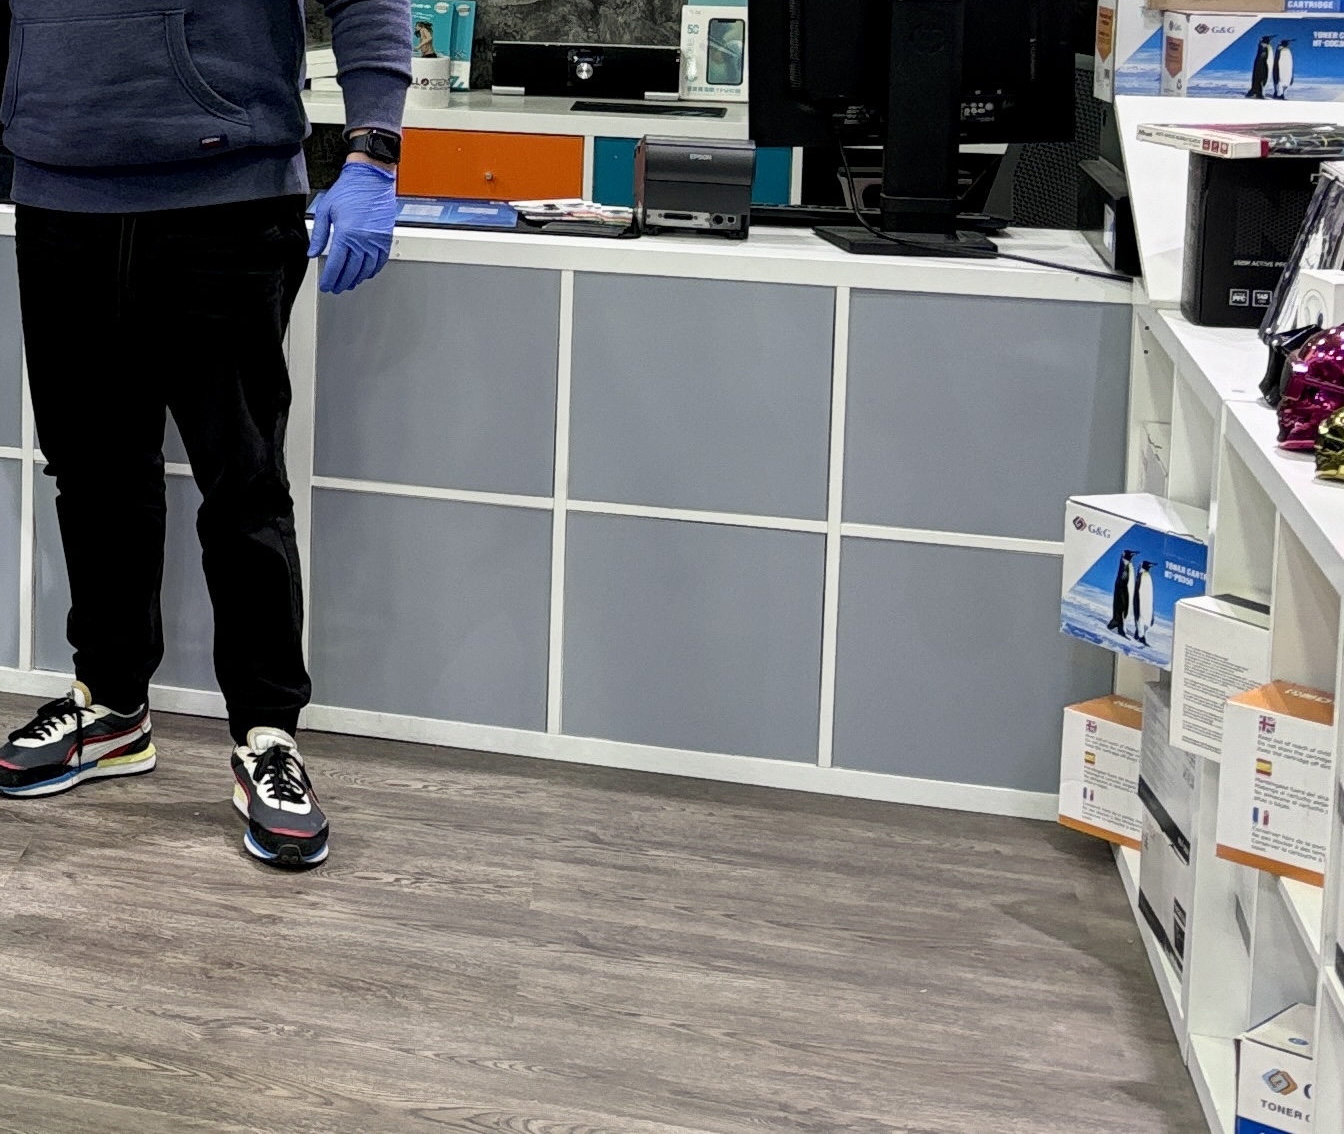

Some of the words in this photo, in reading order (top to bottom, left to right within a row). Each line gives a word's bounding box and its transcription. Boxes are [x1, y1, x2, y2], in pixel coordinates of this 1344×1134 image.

[1287, 0, 1334, 10] CARTRIDGE
[1088, 523, 1111, 539] G&G
[1261, 1099, 1303, 1122] TONER
